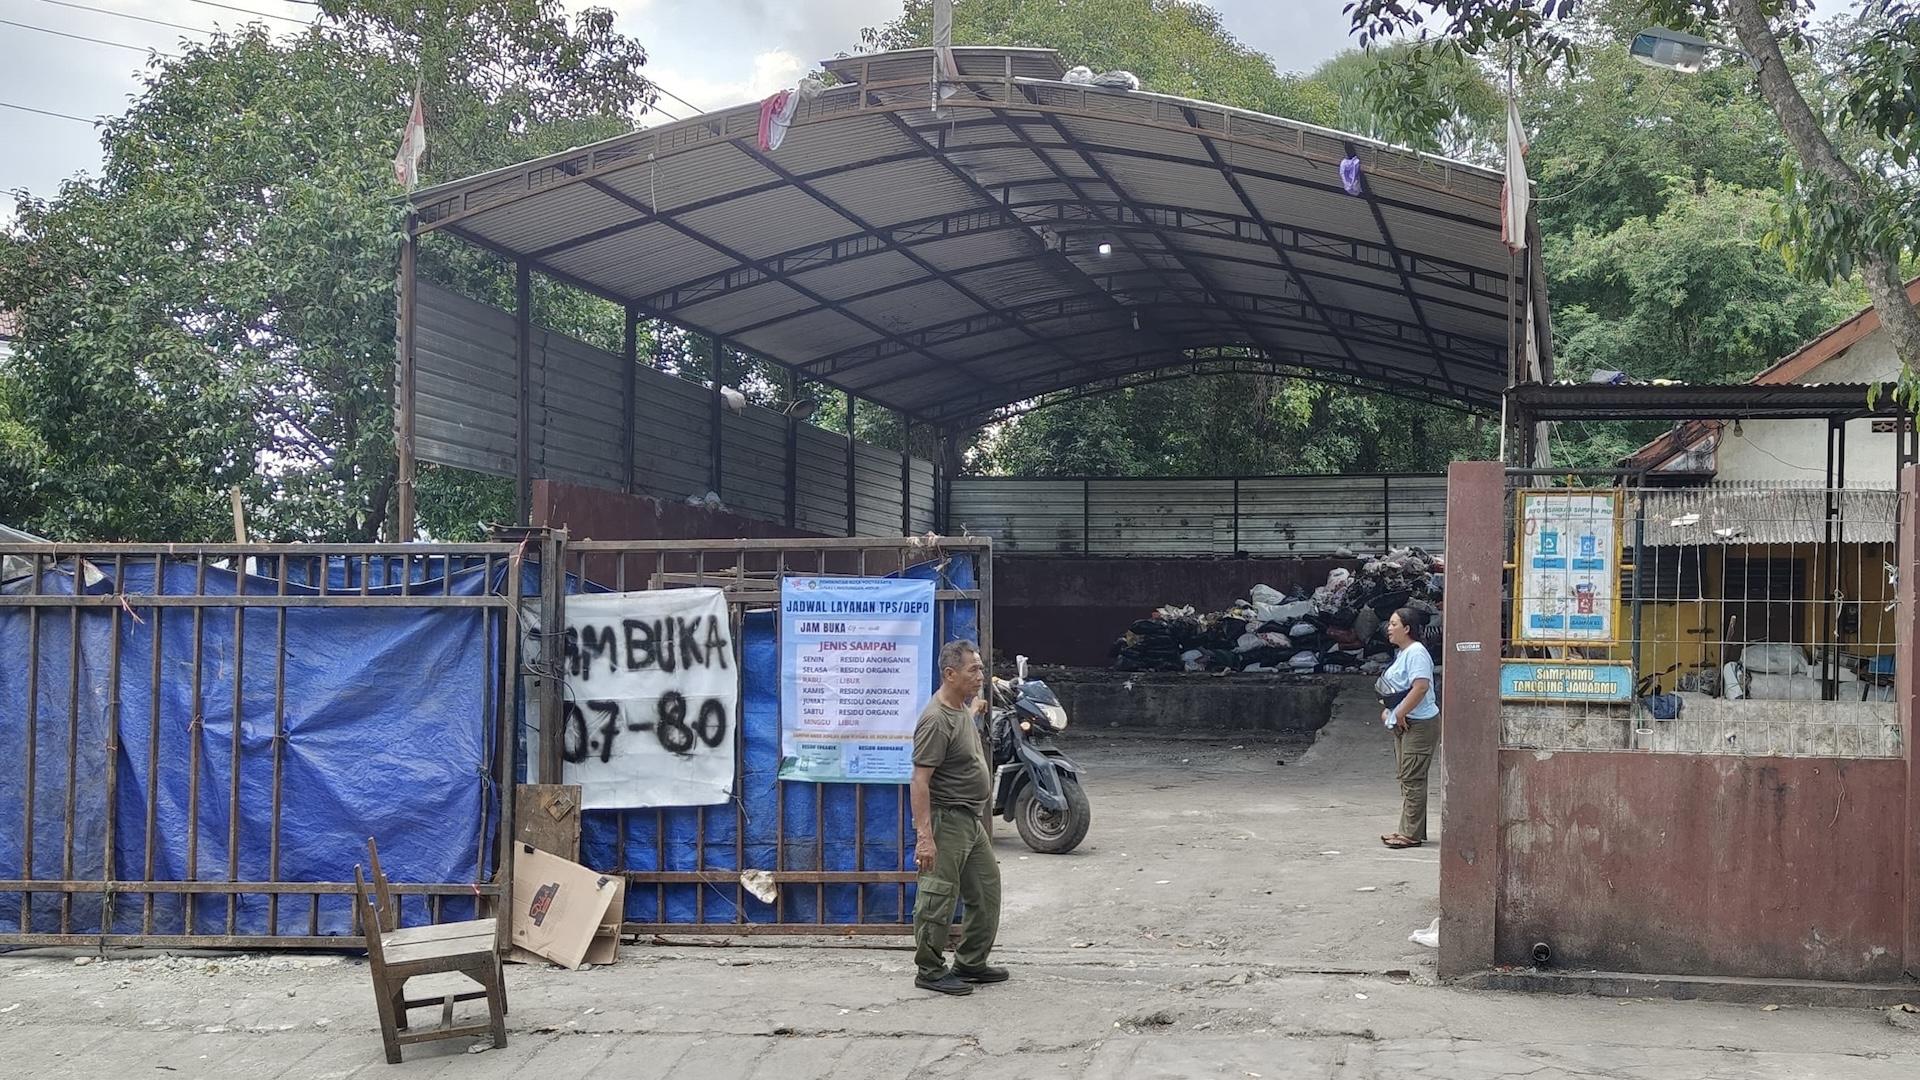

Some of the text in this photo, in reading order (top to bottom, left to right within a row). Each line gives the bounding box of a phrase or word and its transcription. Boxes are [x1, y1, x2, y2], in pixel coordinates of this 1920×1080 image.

[786, 600, 929, 613] JADWAL LAYANAN TPS/DEPO
[800, 622, 820, 633] JAM
[823, 622, 846, 633] BUKA
[622, 614, 727, 672] BUKA
[819, 641, 897, 652] JENIS SAMPAH
[866, 656, 911, 664] ANORGANIK
[1535, 667, 1595, 681] SAMPAHMU
[1566, 681, 1618, 694] JAWABMU
